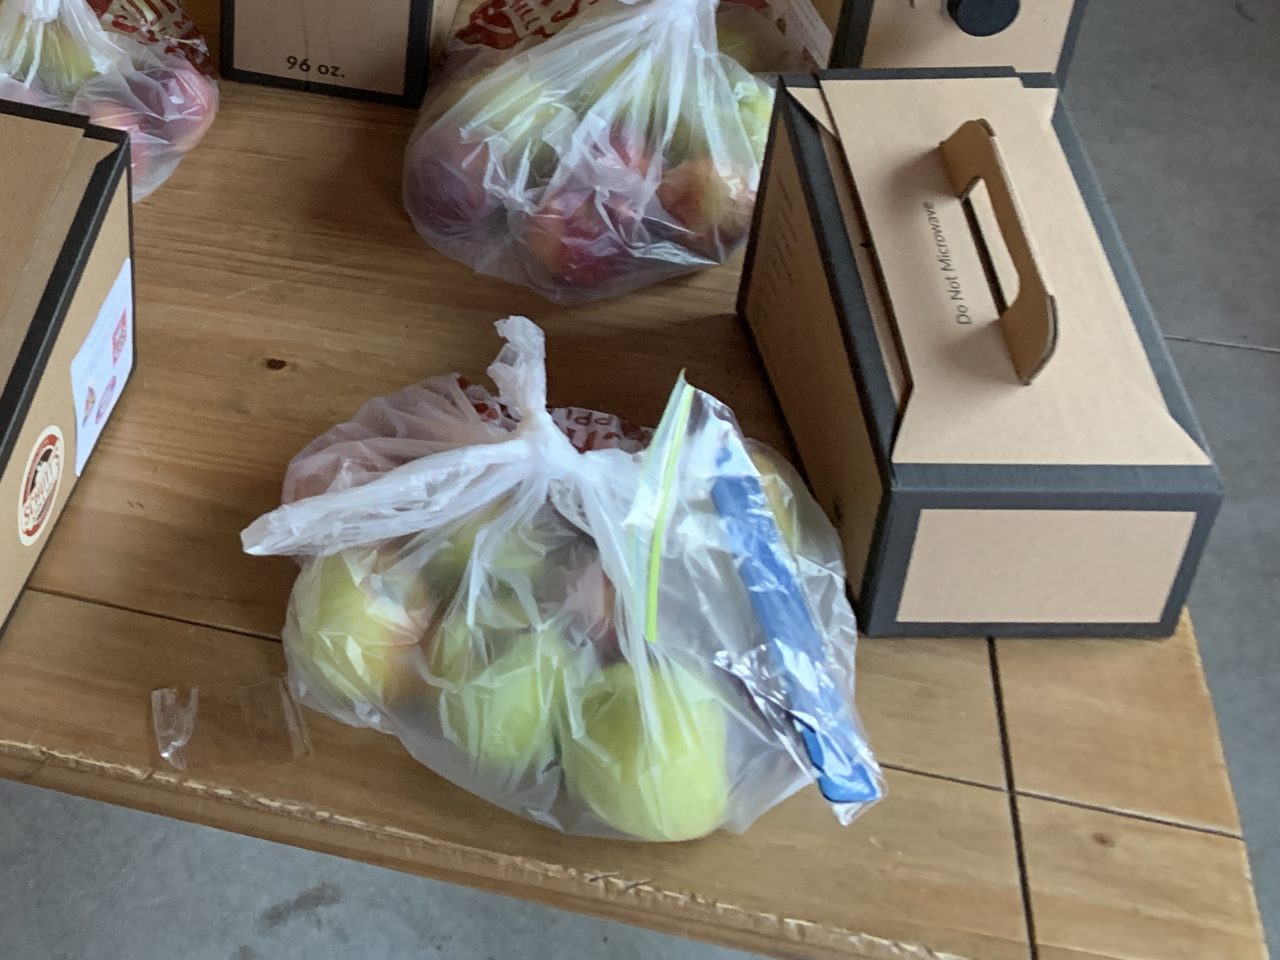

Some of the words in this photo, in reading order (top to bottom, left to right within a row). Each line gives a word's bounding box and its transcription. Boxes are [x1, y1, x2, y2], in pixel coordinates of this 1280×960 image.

[286, 55, 311, 73] 96
[317, 64, 346, 79] oz.
[922, 201, 956, 272] Microwave
[944, 275, 966, 301] Not
[955, 304, 973, 326] Do
